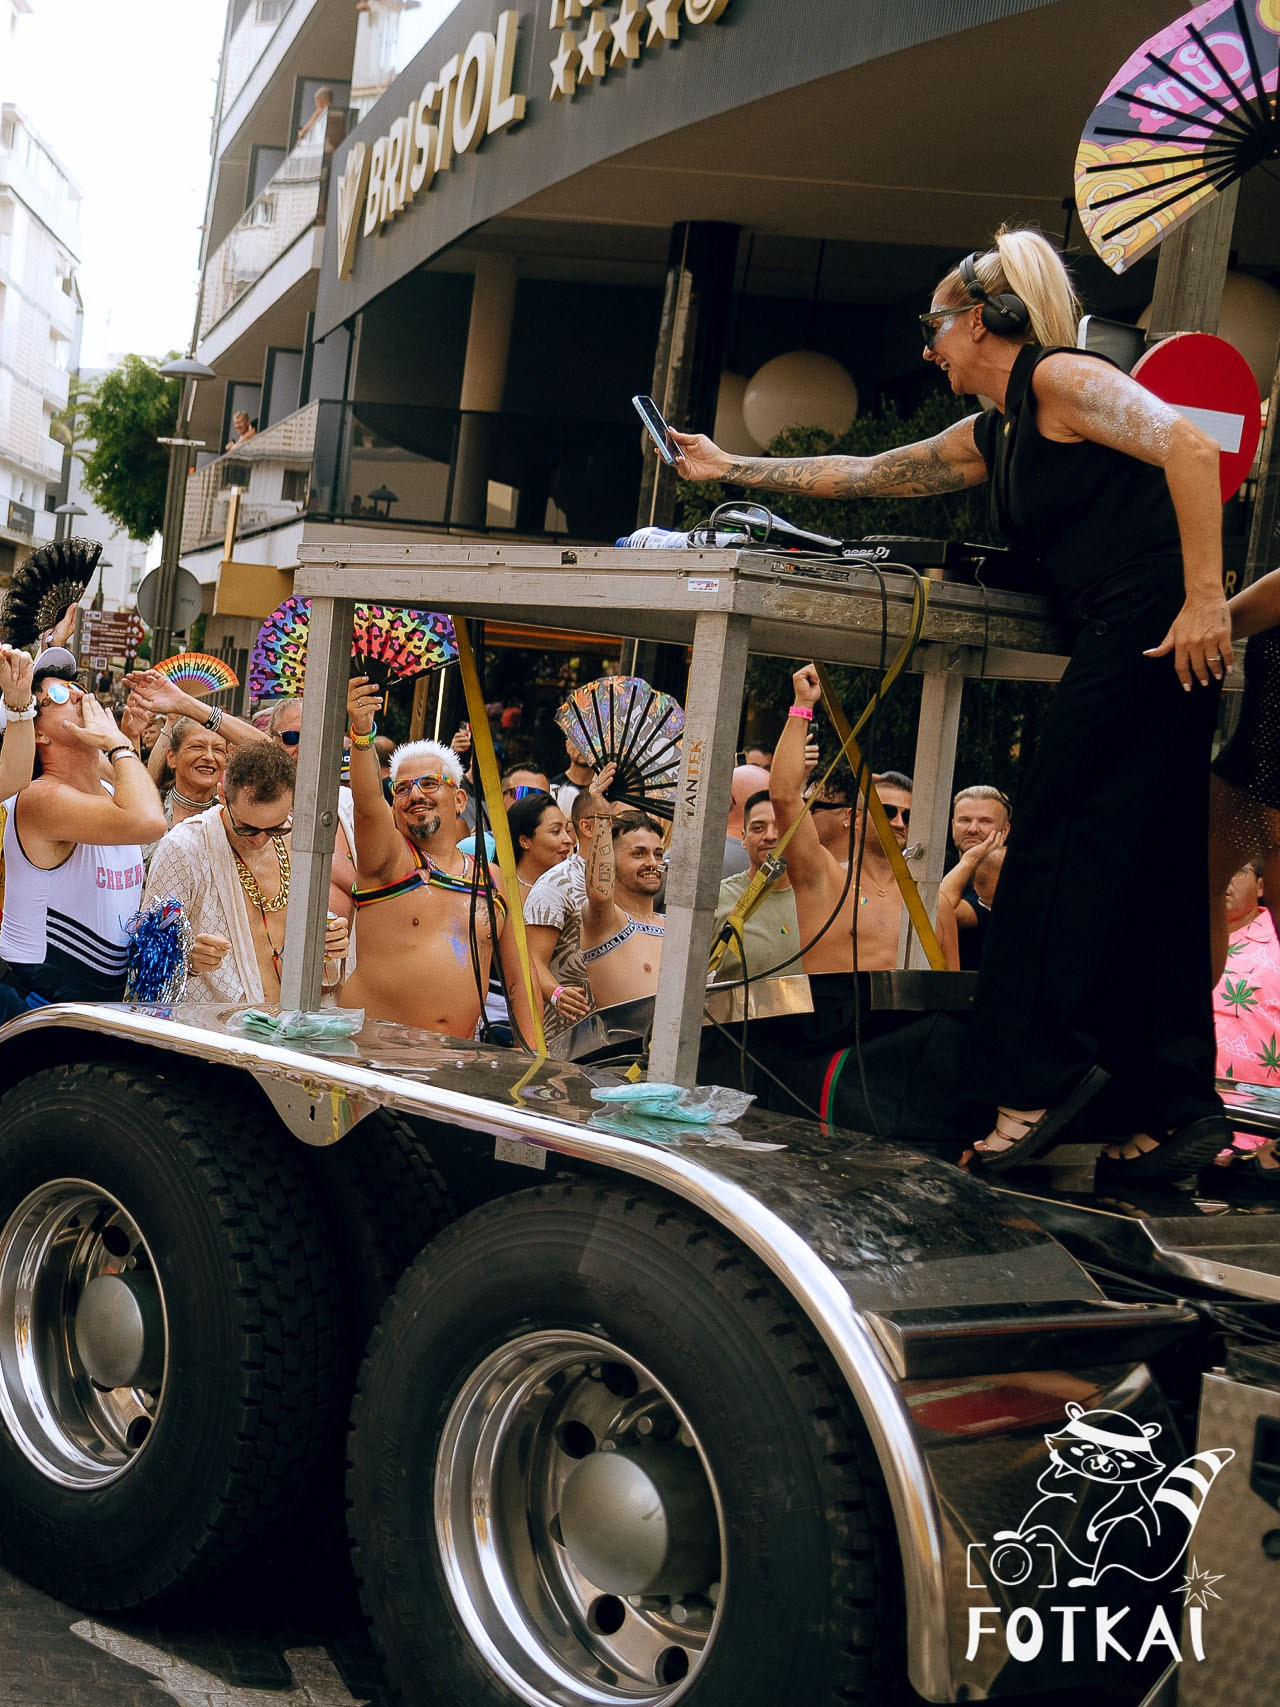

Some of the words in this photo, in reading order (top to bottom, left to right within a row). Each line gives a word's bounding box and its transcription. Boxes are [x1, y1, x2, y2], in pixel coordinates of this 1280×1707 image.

[363, 10, 526, 238] BRISTOL
[876, 547, 890, 559] DJ
[166, 662, 190, 676] STOP
[193, 662, 229, 686] DANCING
[96, 864, 142, 890] CHEER
